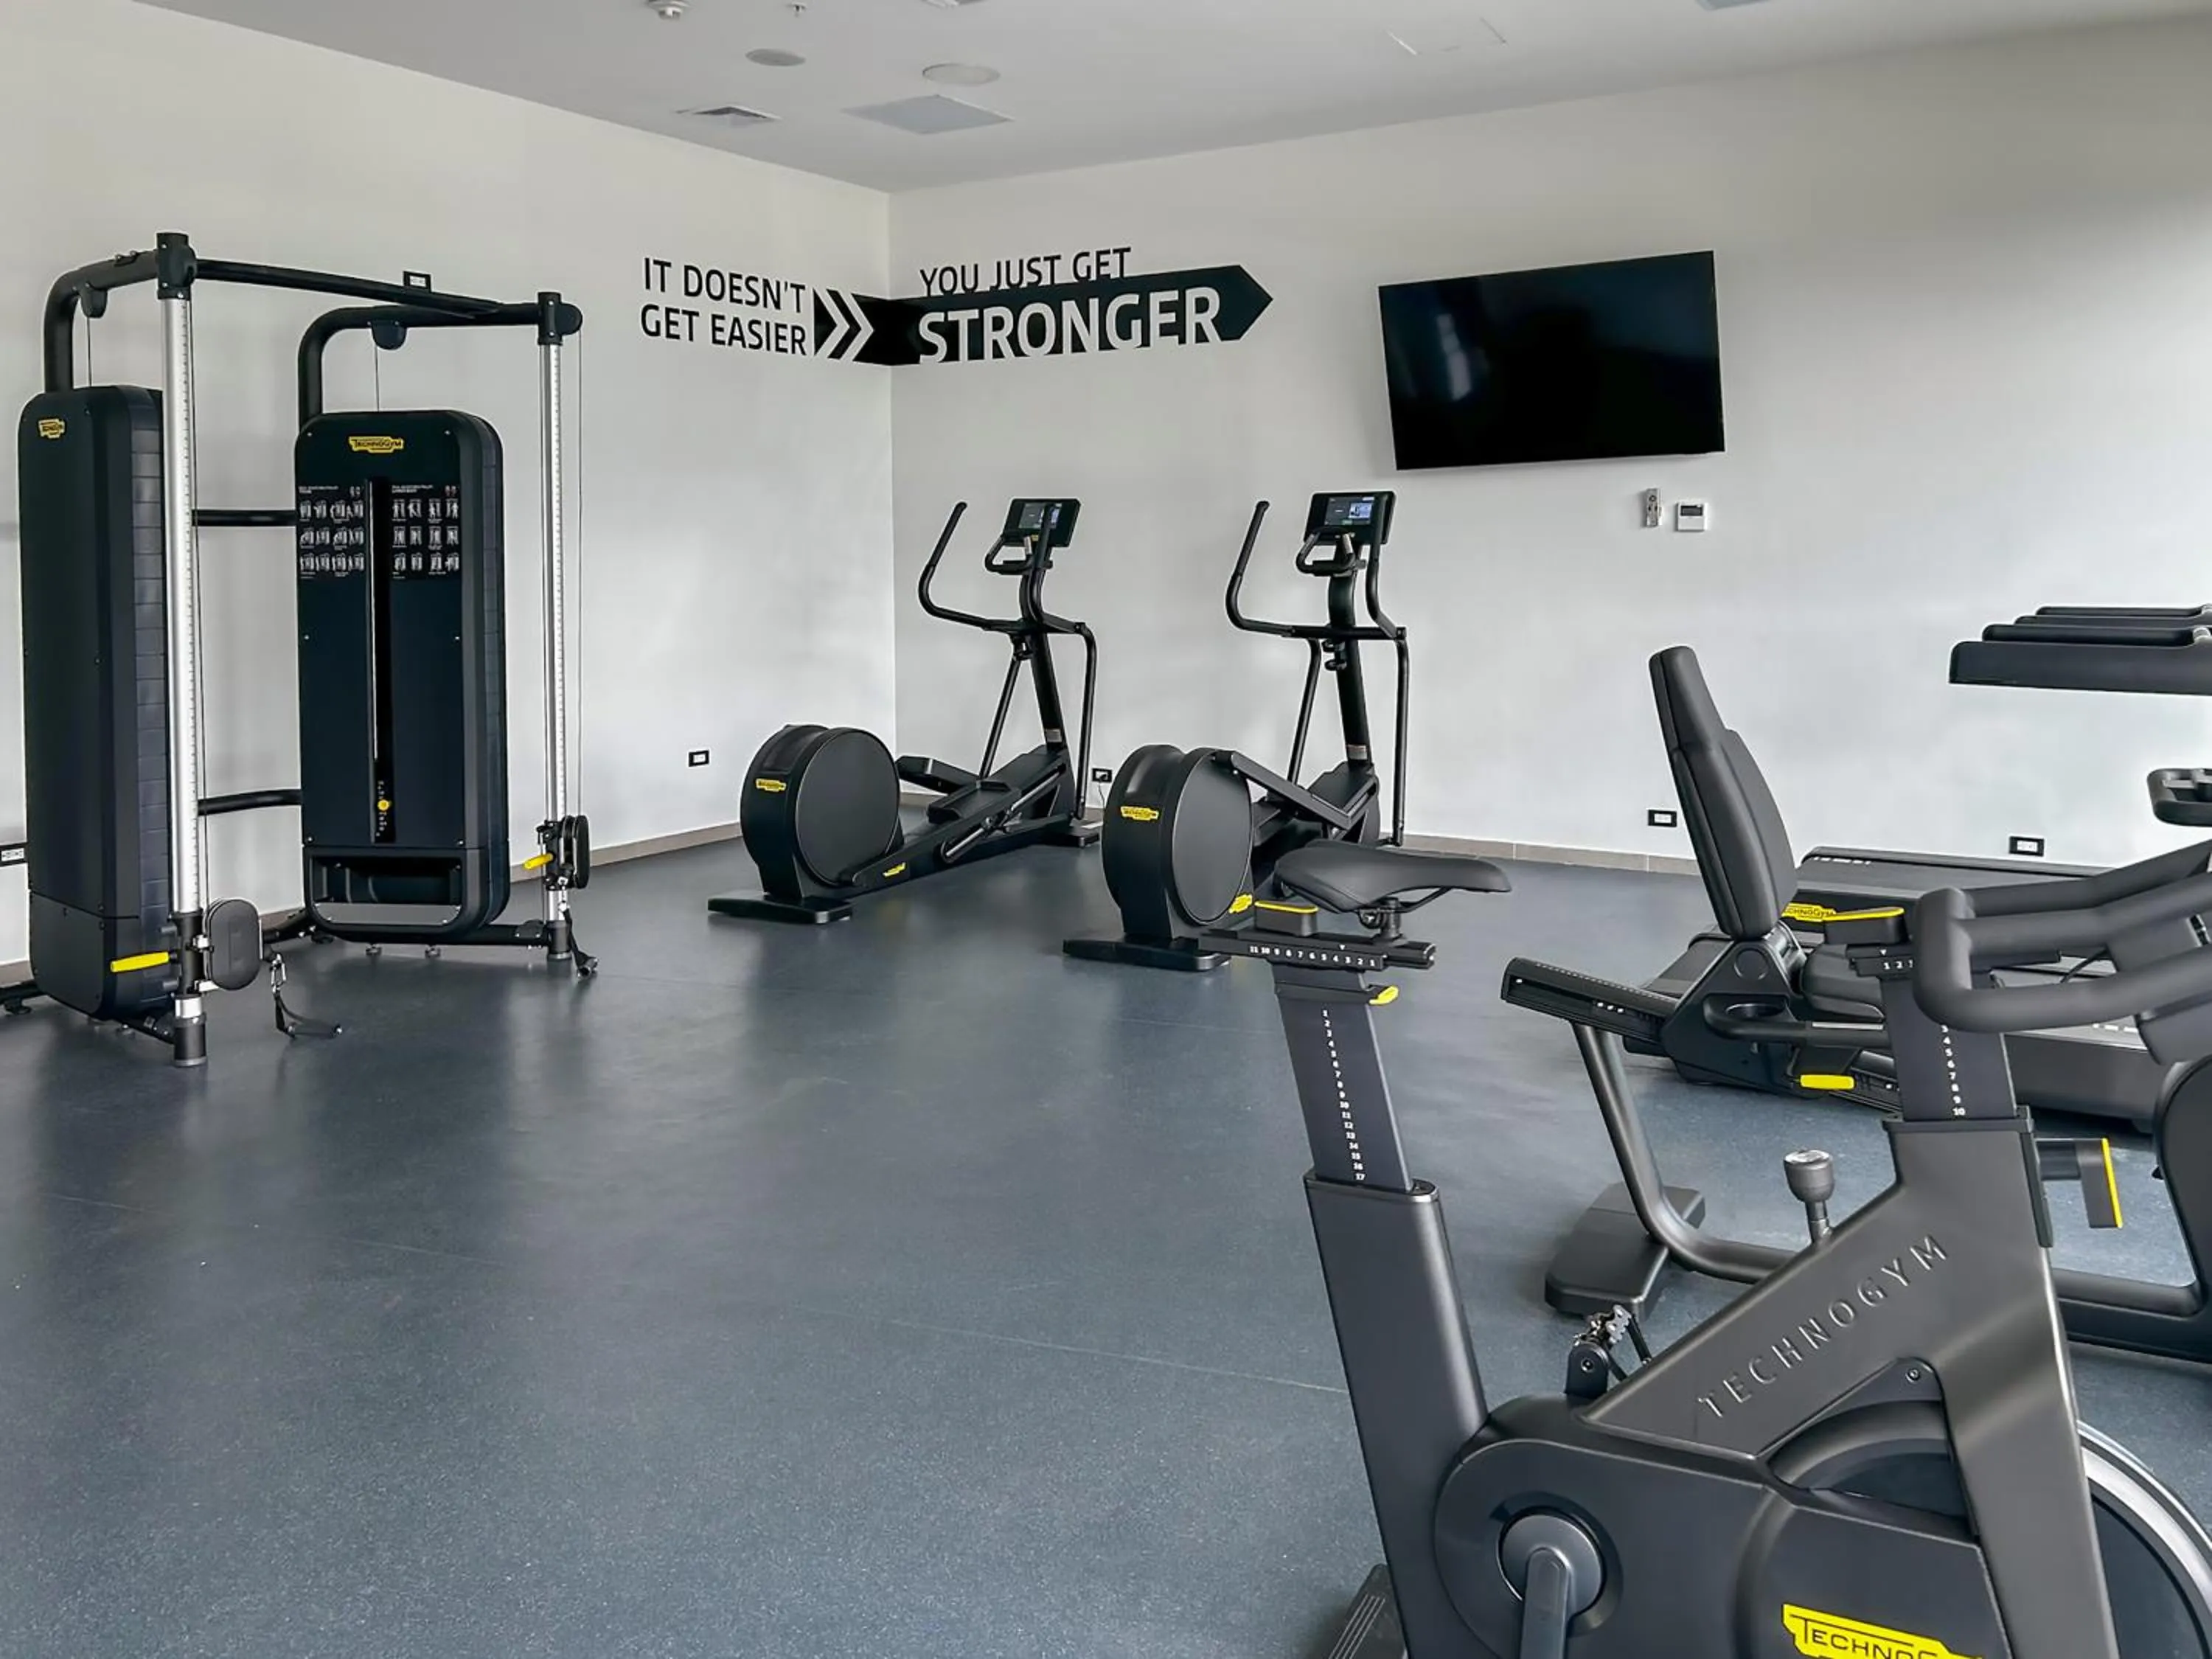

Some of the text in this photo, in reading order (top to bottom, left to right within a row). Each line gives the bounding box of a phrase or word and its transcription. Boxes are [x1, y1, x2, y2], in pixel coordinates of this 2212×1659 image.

[644, 257, 806, 313] IT DOESN'T
[920, 246, 1132, 296] YOU JUST GET
[641, 304, 807, 356] GET EASIER
[918, 286, 1222, 364] STRONGER
[1698, 1234, 1947, 1418] TECHNOGYM
